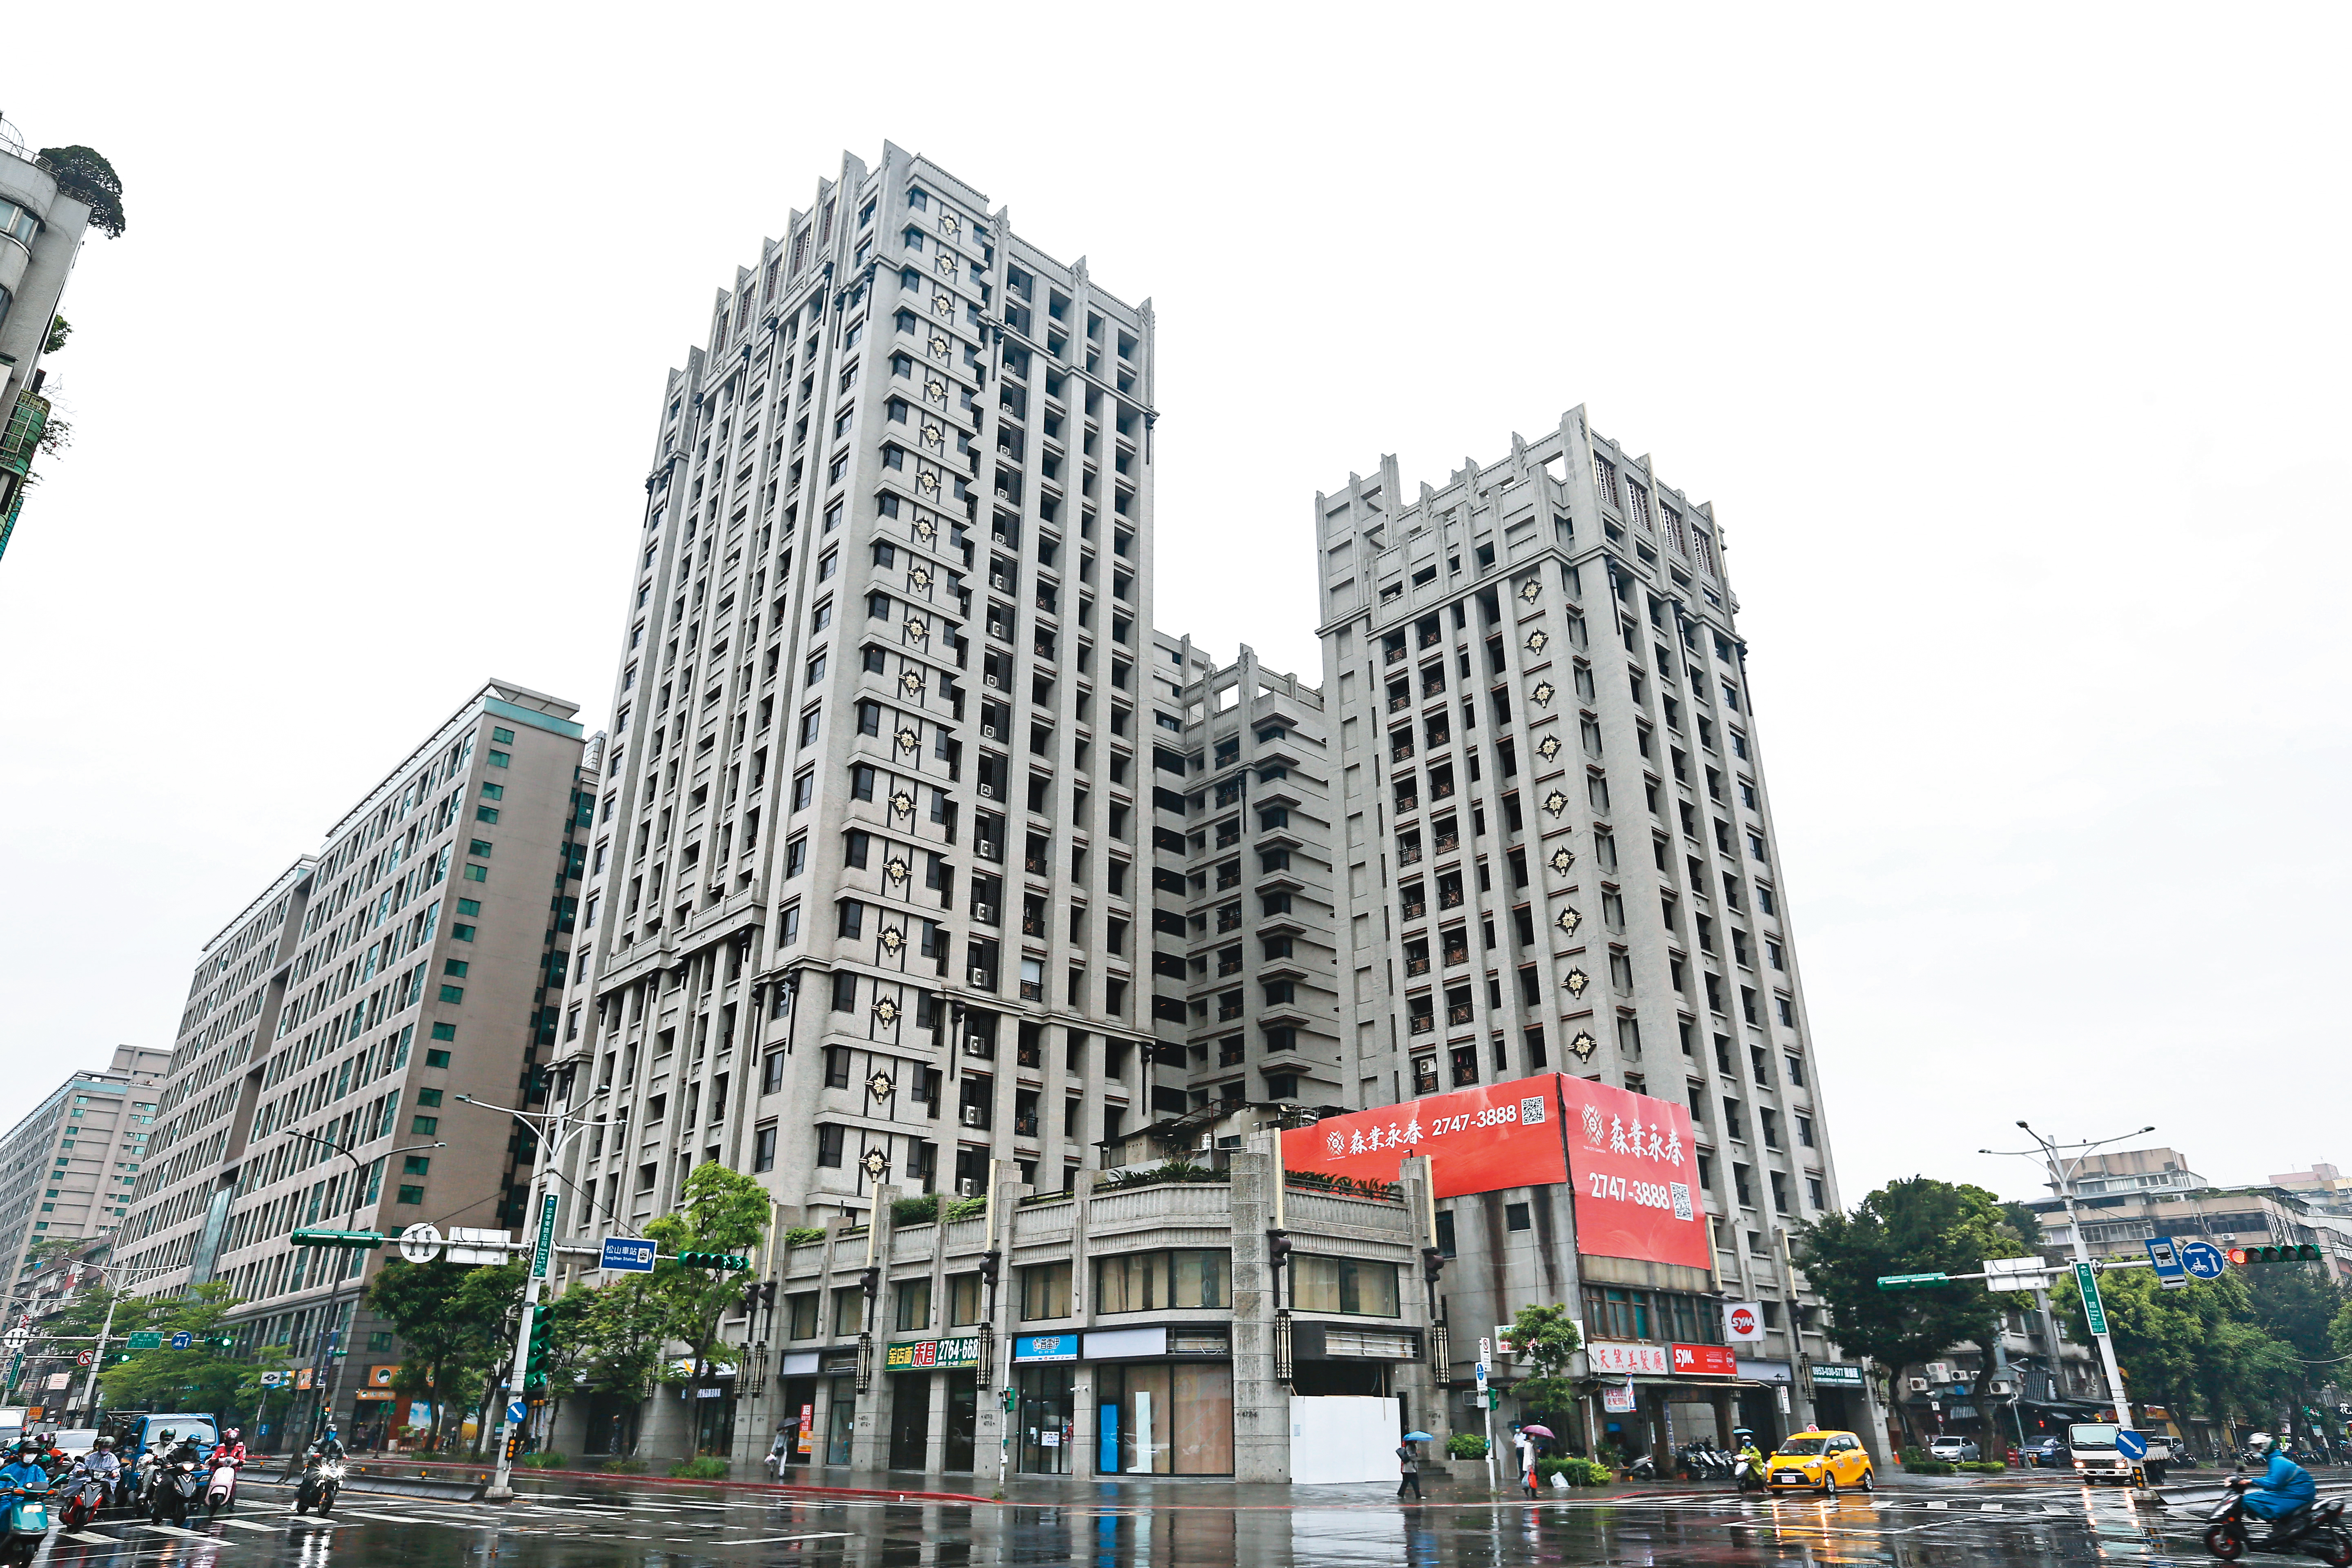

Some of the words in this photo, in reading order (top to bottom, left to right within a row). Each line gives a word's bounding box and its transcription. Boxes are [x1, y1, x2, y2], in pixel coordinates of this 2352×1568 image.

[1349, 1118, 1424, 1155] 森業永春
[1432, 1105, 1517, 1136] 2747-3888
[1610, 1113, 1685, 1167] 森業永春
[1589, 1172, 1670, 1210] 2747-3888
[541, 1207, 553, 1247] 忠孝東路五段
[606, 1245, 637, 1256] 松山車站
[2080, 1270, 2097, 1308] 松山路
[1731, 1317, 1754, 1330] SYM
[887, 1346, 913, 1365] 金店面
[912, 1341, 937, 1367] 租
[938, 1339, 978, 1361] 2764-668
[1041, 1337, 1060, 1350] 普雷伊
[1600, 1348, 1664, 1371] 天然美髮廳
[1675, 1349, 1695, 1367] SYM
[802, 1405, 811, 1415] 租
